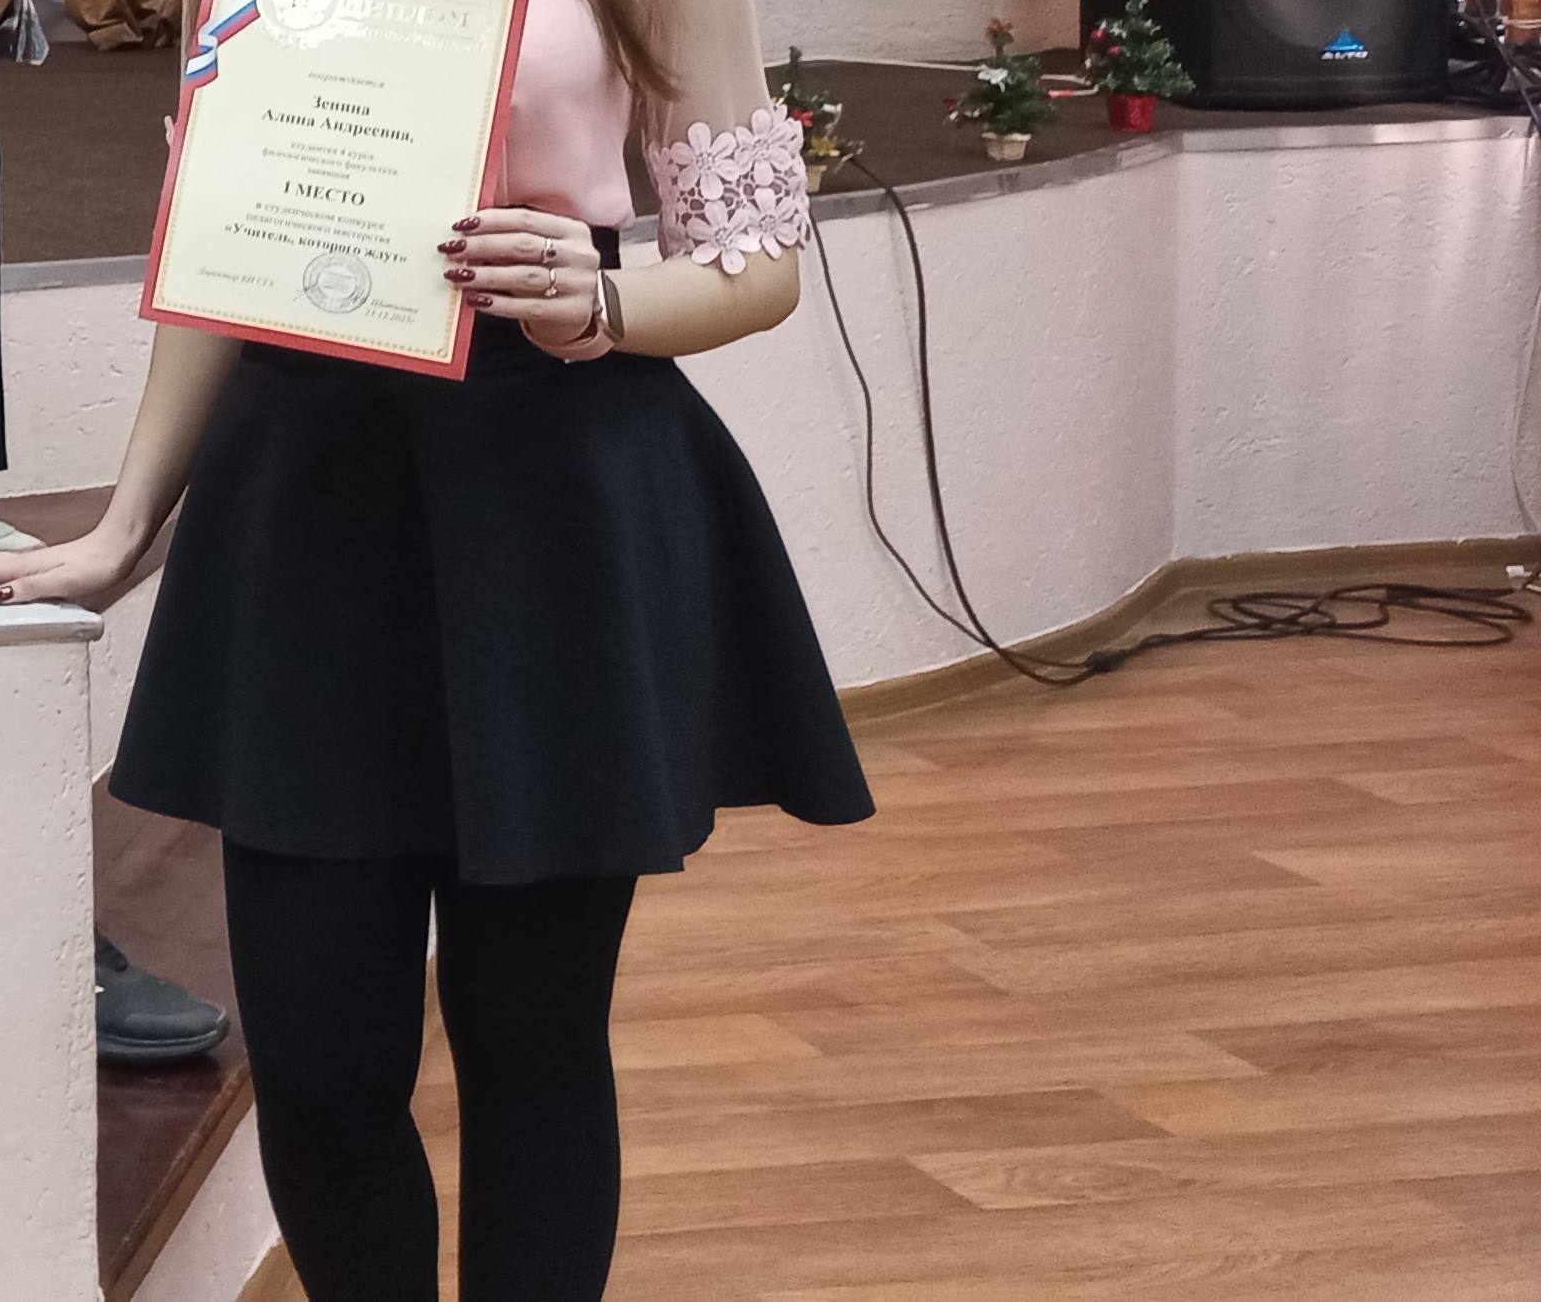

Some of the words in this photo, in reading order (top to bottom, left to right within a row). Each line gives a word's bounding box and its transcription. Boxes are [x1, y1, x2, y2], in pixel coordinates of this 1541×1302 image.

[313, 95, 370, 116] Зенина
[262, 109, 315, 128] Алина
[320, 119, 414, 144] Андреевна,
[296, 183, 365, 207] МЕСТО
[225, 222, 295, 246] «Учитель,
[298, 236, 361, 255] которого
[365, 248, 407, 264] ждут»
